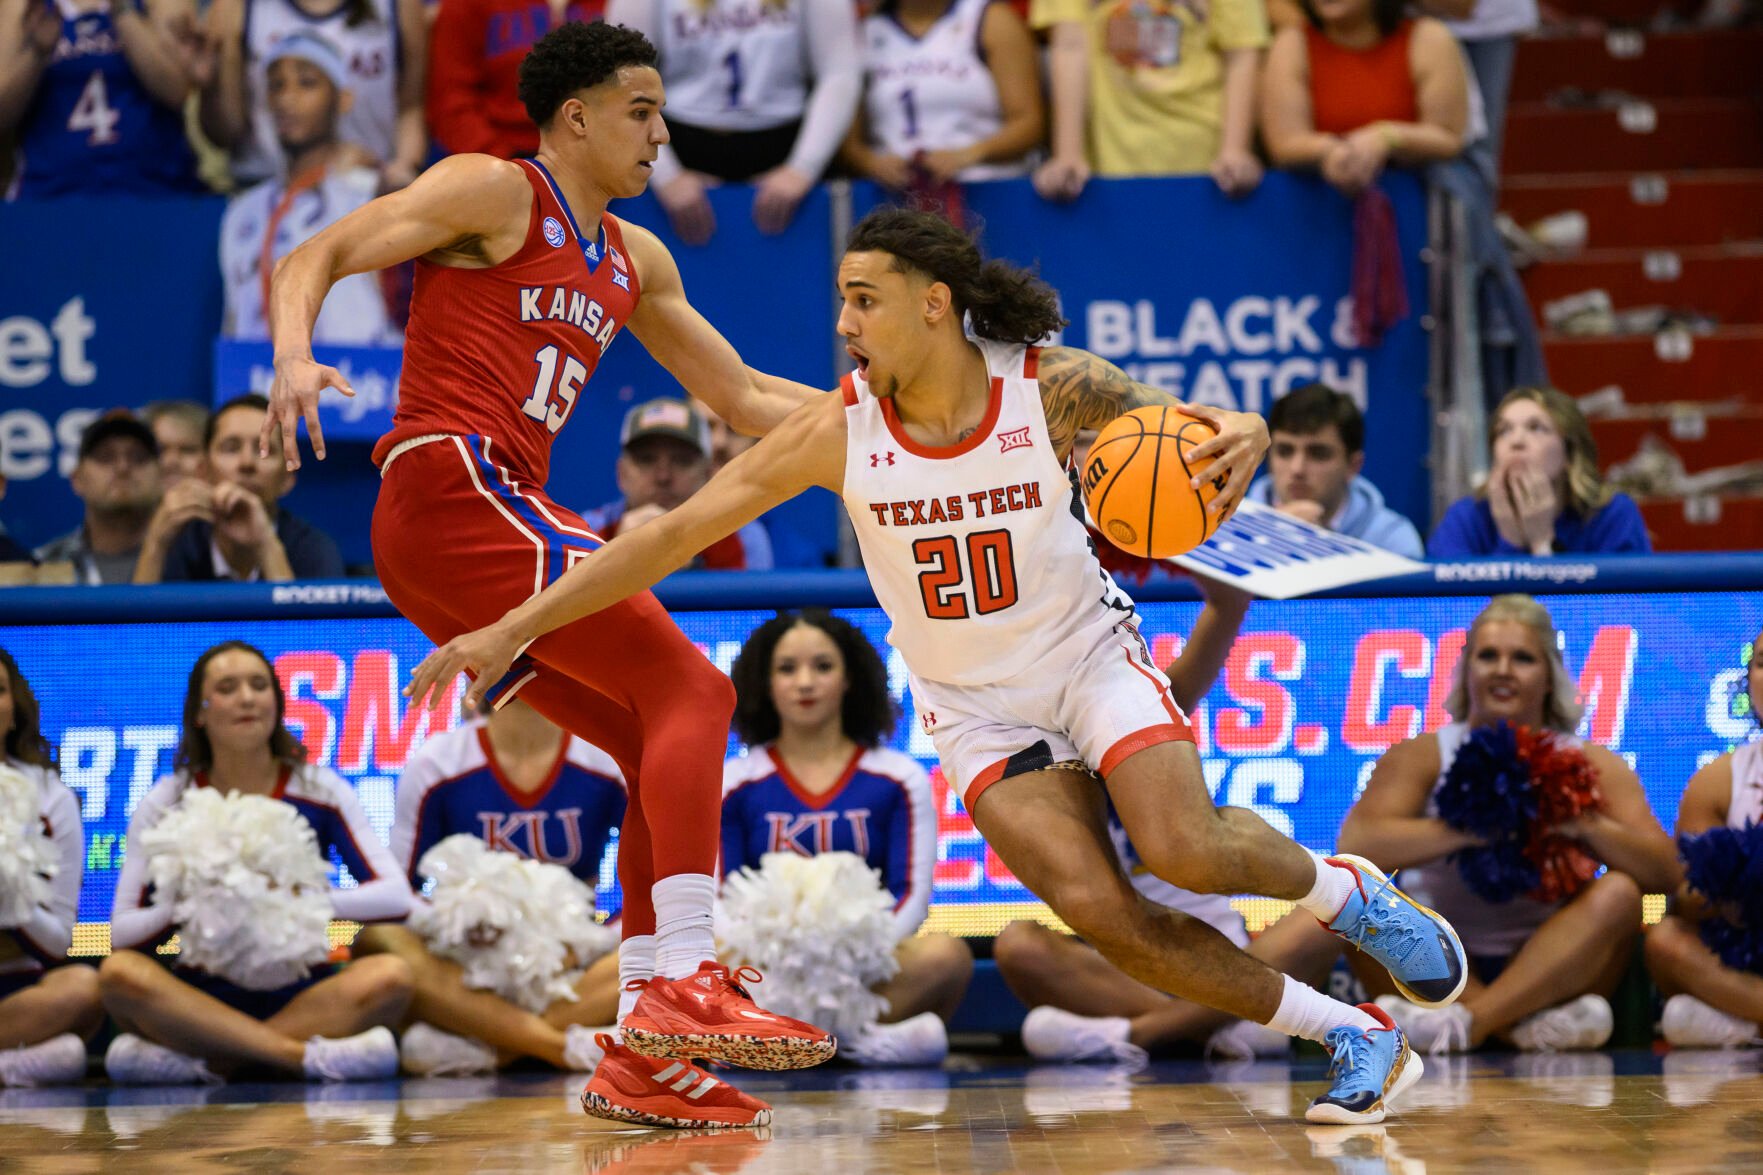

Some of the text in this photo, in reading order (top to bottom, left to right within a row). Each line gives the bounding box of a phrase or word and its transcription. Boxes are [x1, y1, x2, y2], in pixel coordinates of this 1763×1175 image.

[67, 70, 121, 146] 4
[721, 50, 746, 108] 1
[897, 88, 917, 138] 1
[0, 296, 97, 389] et
[1087, 295, 1324, 358] BLACK
[521, 343, 588, 435] 15
[1122, 356, 1369, 414] EATCH
[869, 495, 965, 526] TEXAS
[968, 481, 1043, 519] TECH
[272, 585, 349, 604] ROCKET
[911, 528, 1019, 620] 20
[1435, 562, 1511, 582] ROCKET
[477, 808, 583, 867] KU
[764, 809, 872, 859] KU
